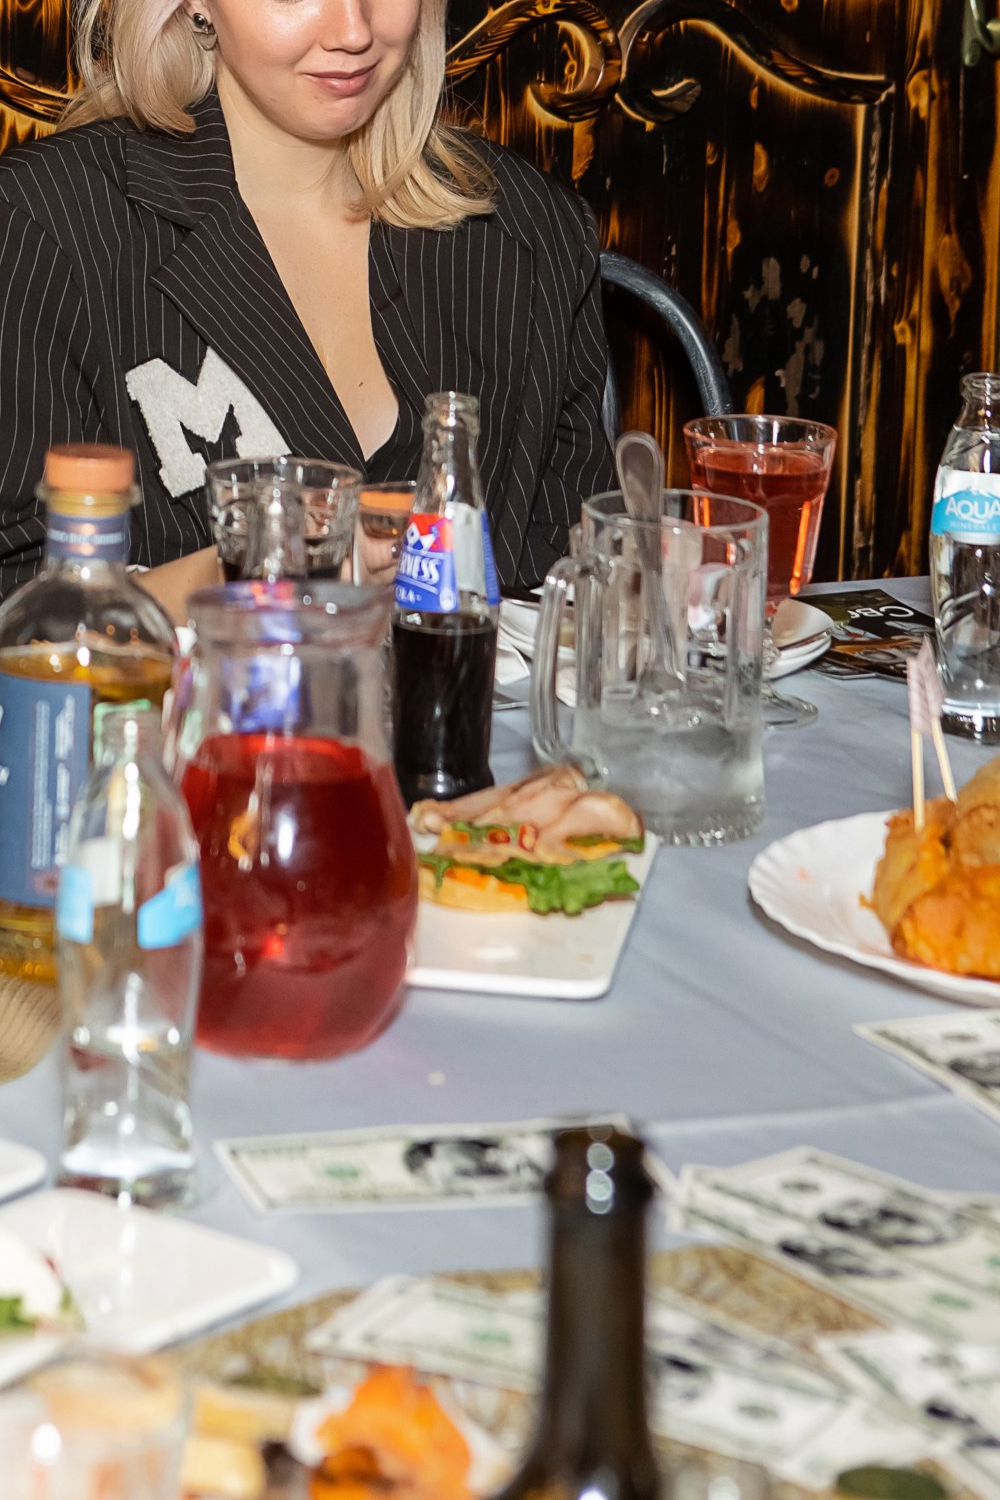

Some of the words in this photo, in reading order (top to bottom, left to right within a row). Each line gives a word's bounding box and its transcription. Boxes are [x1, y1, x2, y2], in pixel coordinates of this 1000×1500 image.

[125, 345, 292, 498] M
[945, 496, 1000, 522] AQUA
[395, 586, 415, 604] OLA
